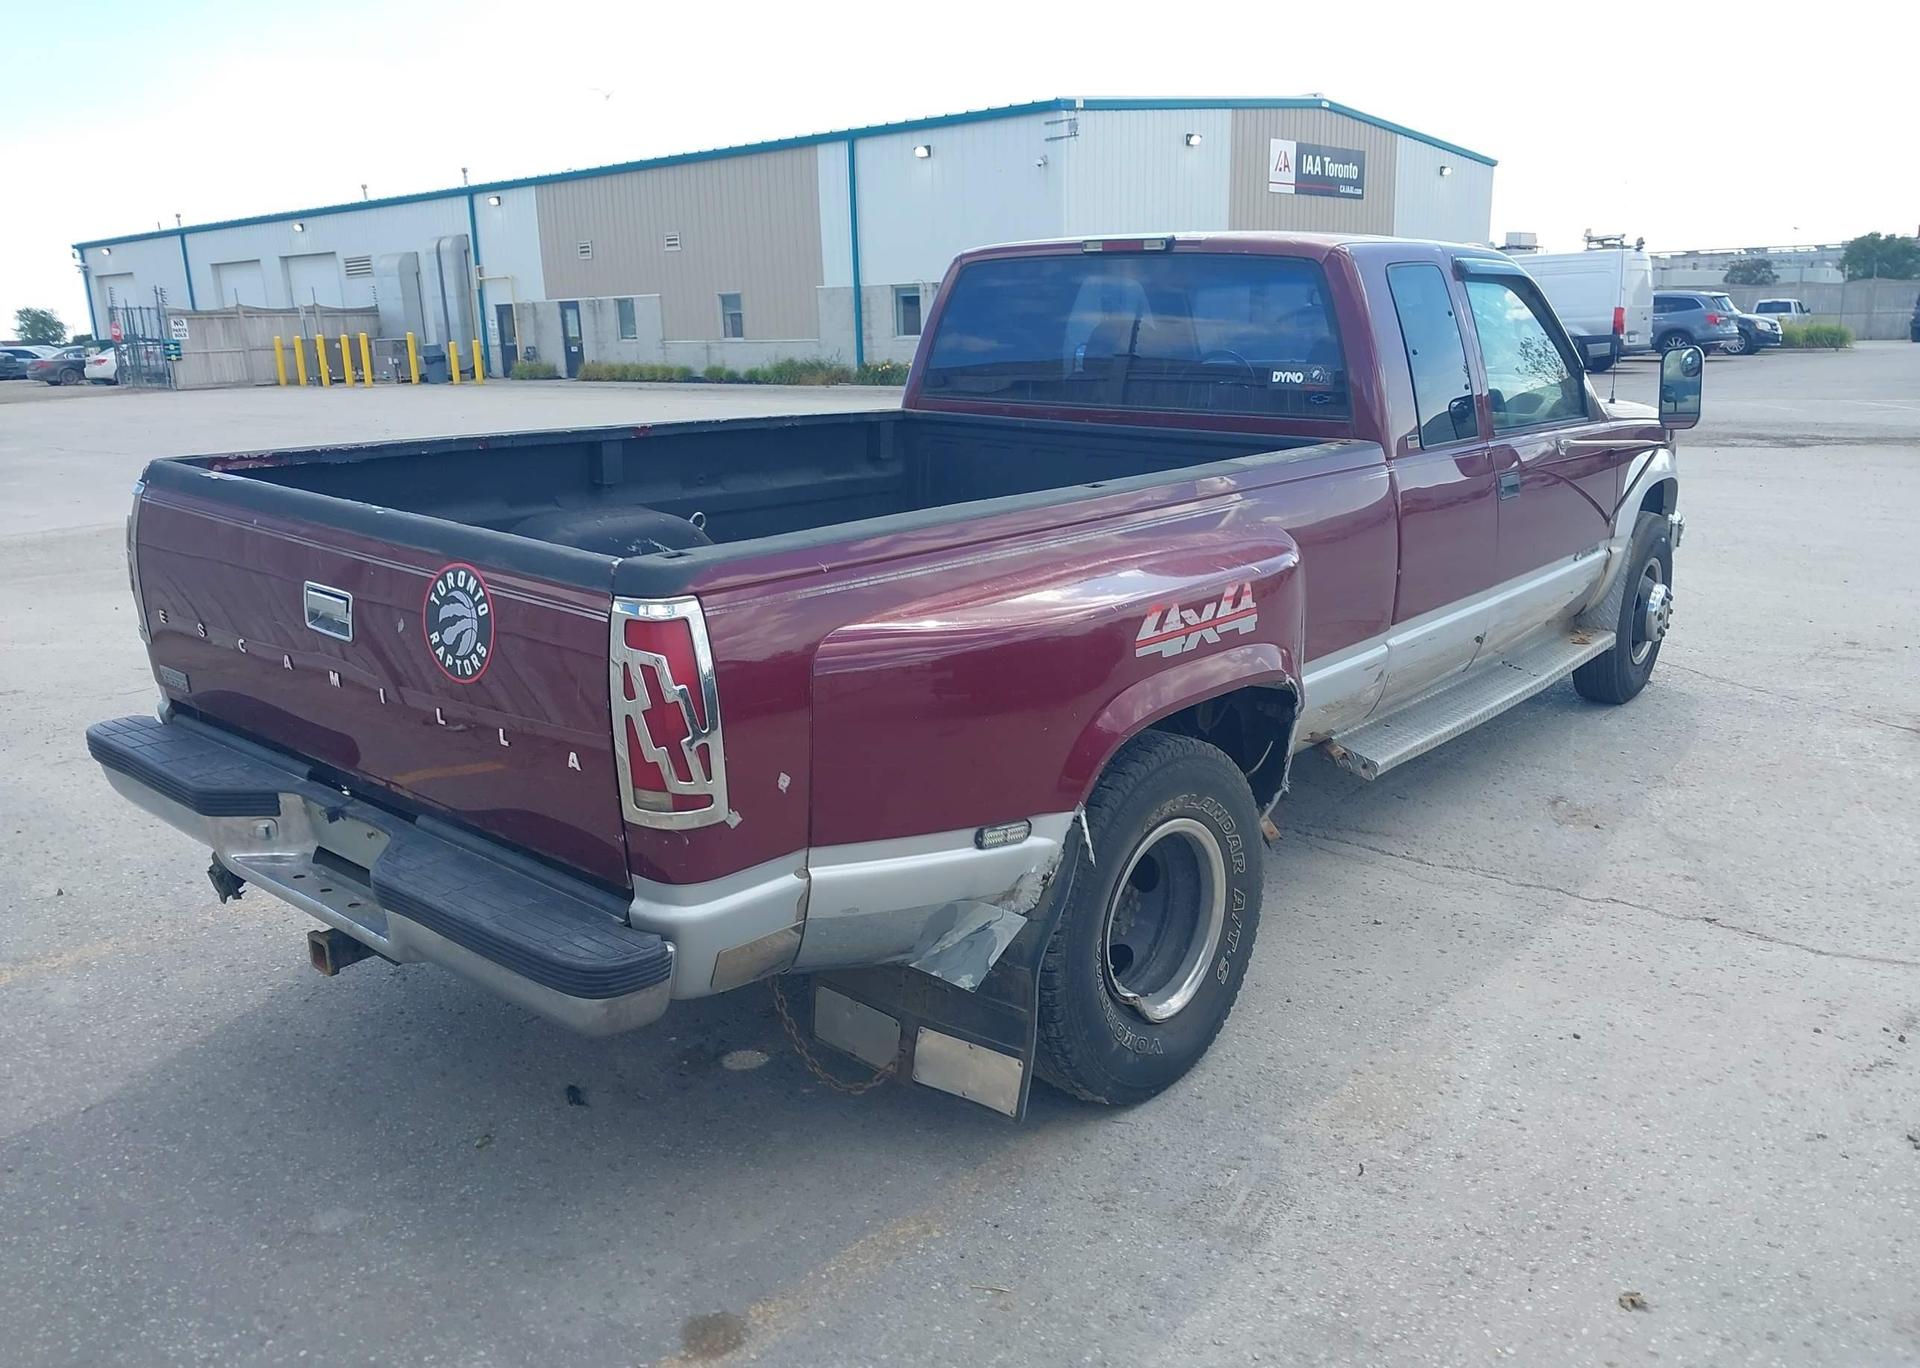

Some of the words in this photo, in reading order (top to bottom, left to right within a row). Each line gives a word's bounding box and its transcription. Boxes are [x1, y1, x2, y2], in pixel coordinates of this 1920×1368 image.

[1302, 154, 1321, 175] IAA
[1323, 156, 1359, 179] Toronto
[173, 319, 184, 327] NO
[430, 570, 489, 617] TORONTO
[429, 630, 487, 676] RAPTORS
